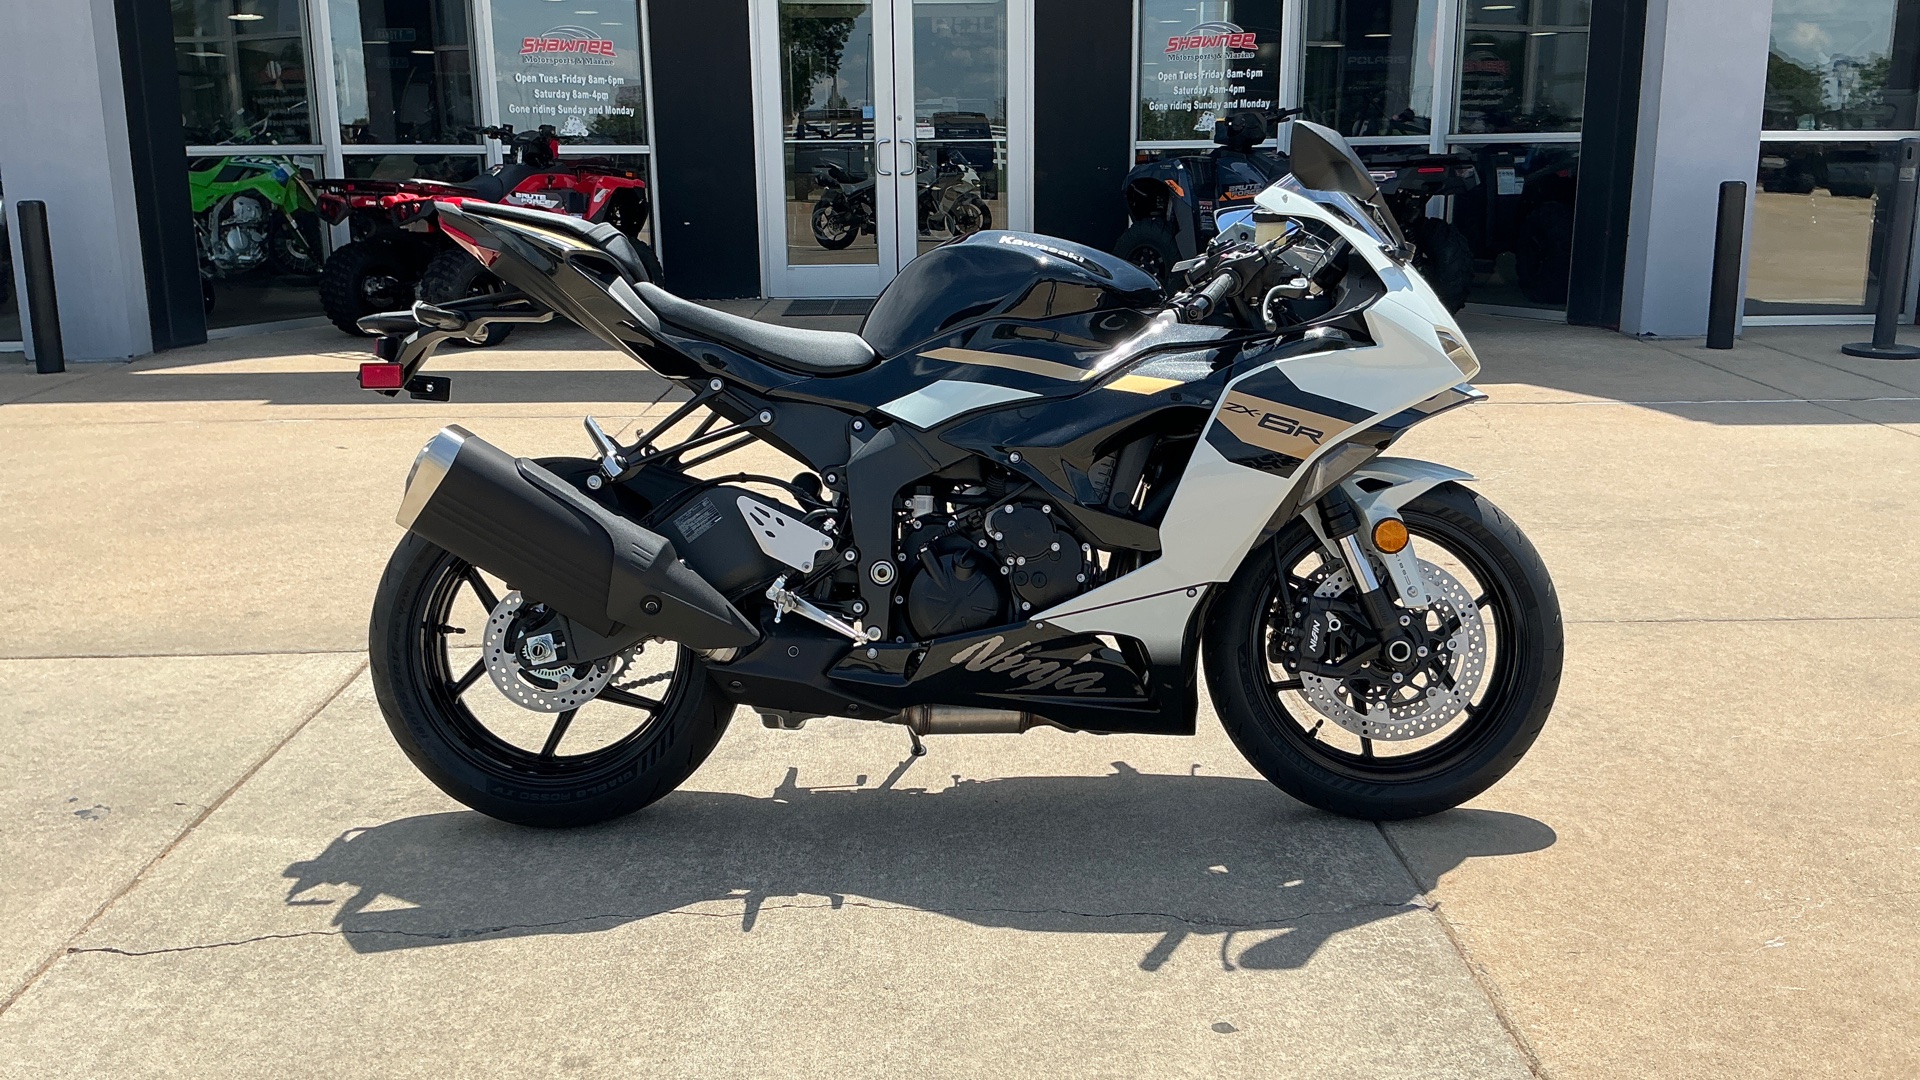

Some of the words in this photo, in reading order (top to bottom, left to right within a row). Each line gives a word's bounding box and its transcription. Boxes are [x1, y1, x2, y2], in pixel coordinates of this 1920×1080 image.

[524, 55, 575, 66] Motorsports
[584, 57, 615, 66] Marine
[1167, 53, 1215, 62] Motorsports
[1225, 51, 1255, 60] Marine
[515, 73, 537, 84] Open
[588, 74, 624, 87] 8am-6pm
[1158, 71, 1177, 82] Open
[1226, 68, 1263, 80] 8am-6pm
[534, 89, 570, 101] Saturday
[572, 90, 609, 101] 8am-4pm
[1173, 85, 1207, 97] Saturday
[1209, 84, 1245, 95] 8am-4pm
[509, 104, 531, 114] Gone
[532, 104, 556, 116] riding
[557, 105, 587, 117] Sunday
[588, 105, 603, 115] and
[605, 105, 635, 117] Monday
[1149, 101, 1168, 111] Gone
[1170, 101, 1192, 112] riding
[1193, 100, 1221, 111] Sunday
[1223, 99, 1238, 109] and
[1239, 99, 1271, 110] Monday
[1229, 183, 1261, 192] BRUTE
[516, 192, 546, 200] BRUTE
[521, 198, 552, 206] FORCE
[999, 235, 1085, 263] Kawasaki
[1222, 402, 1324, 445] ZX-6R
[1309, 620, 1321, 652] NISSIN
[950, 635, 1106, 693] Ninja
[518, 789, 570, 801] ROSSO
